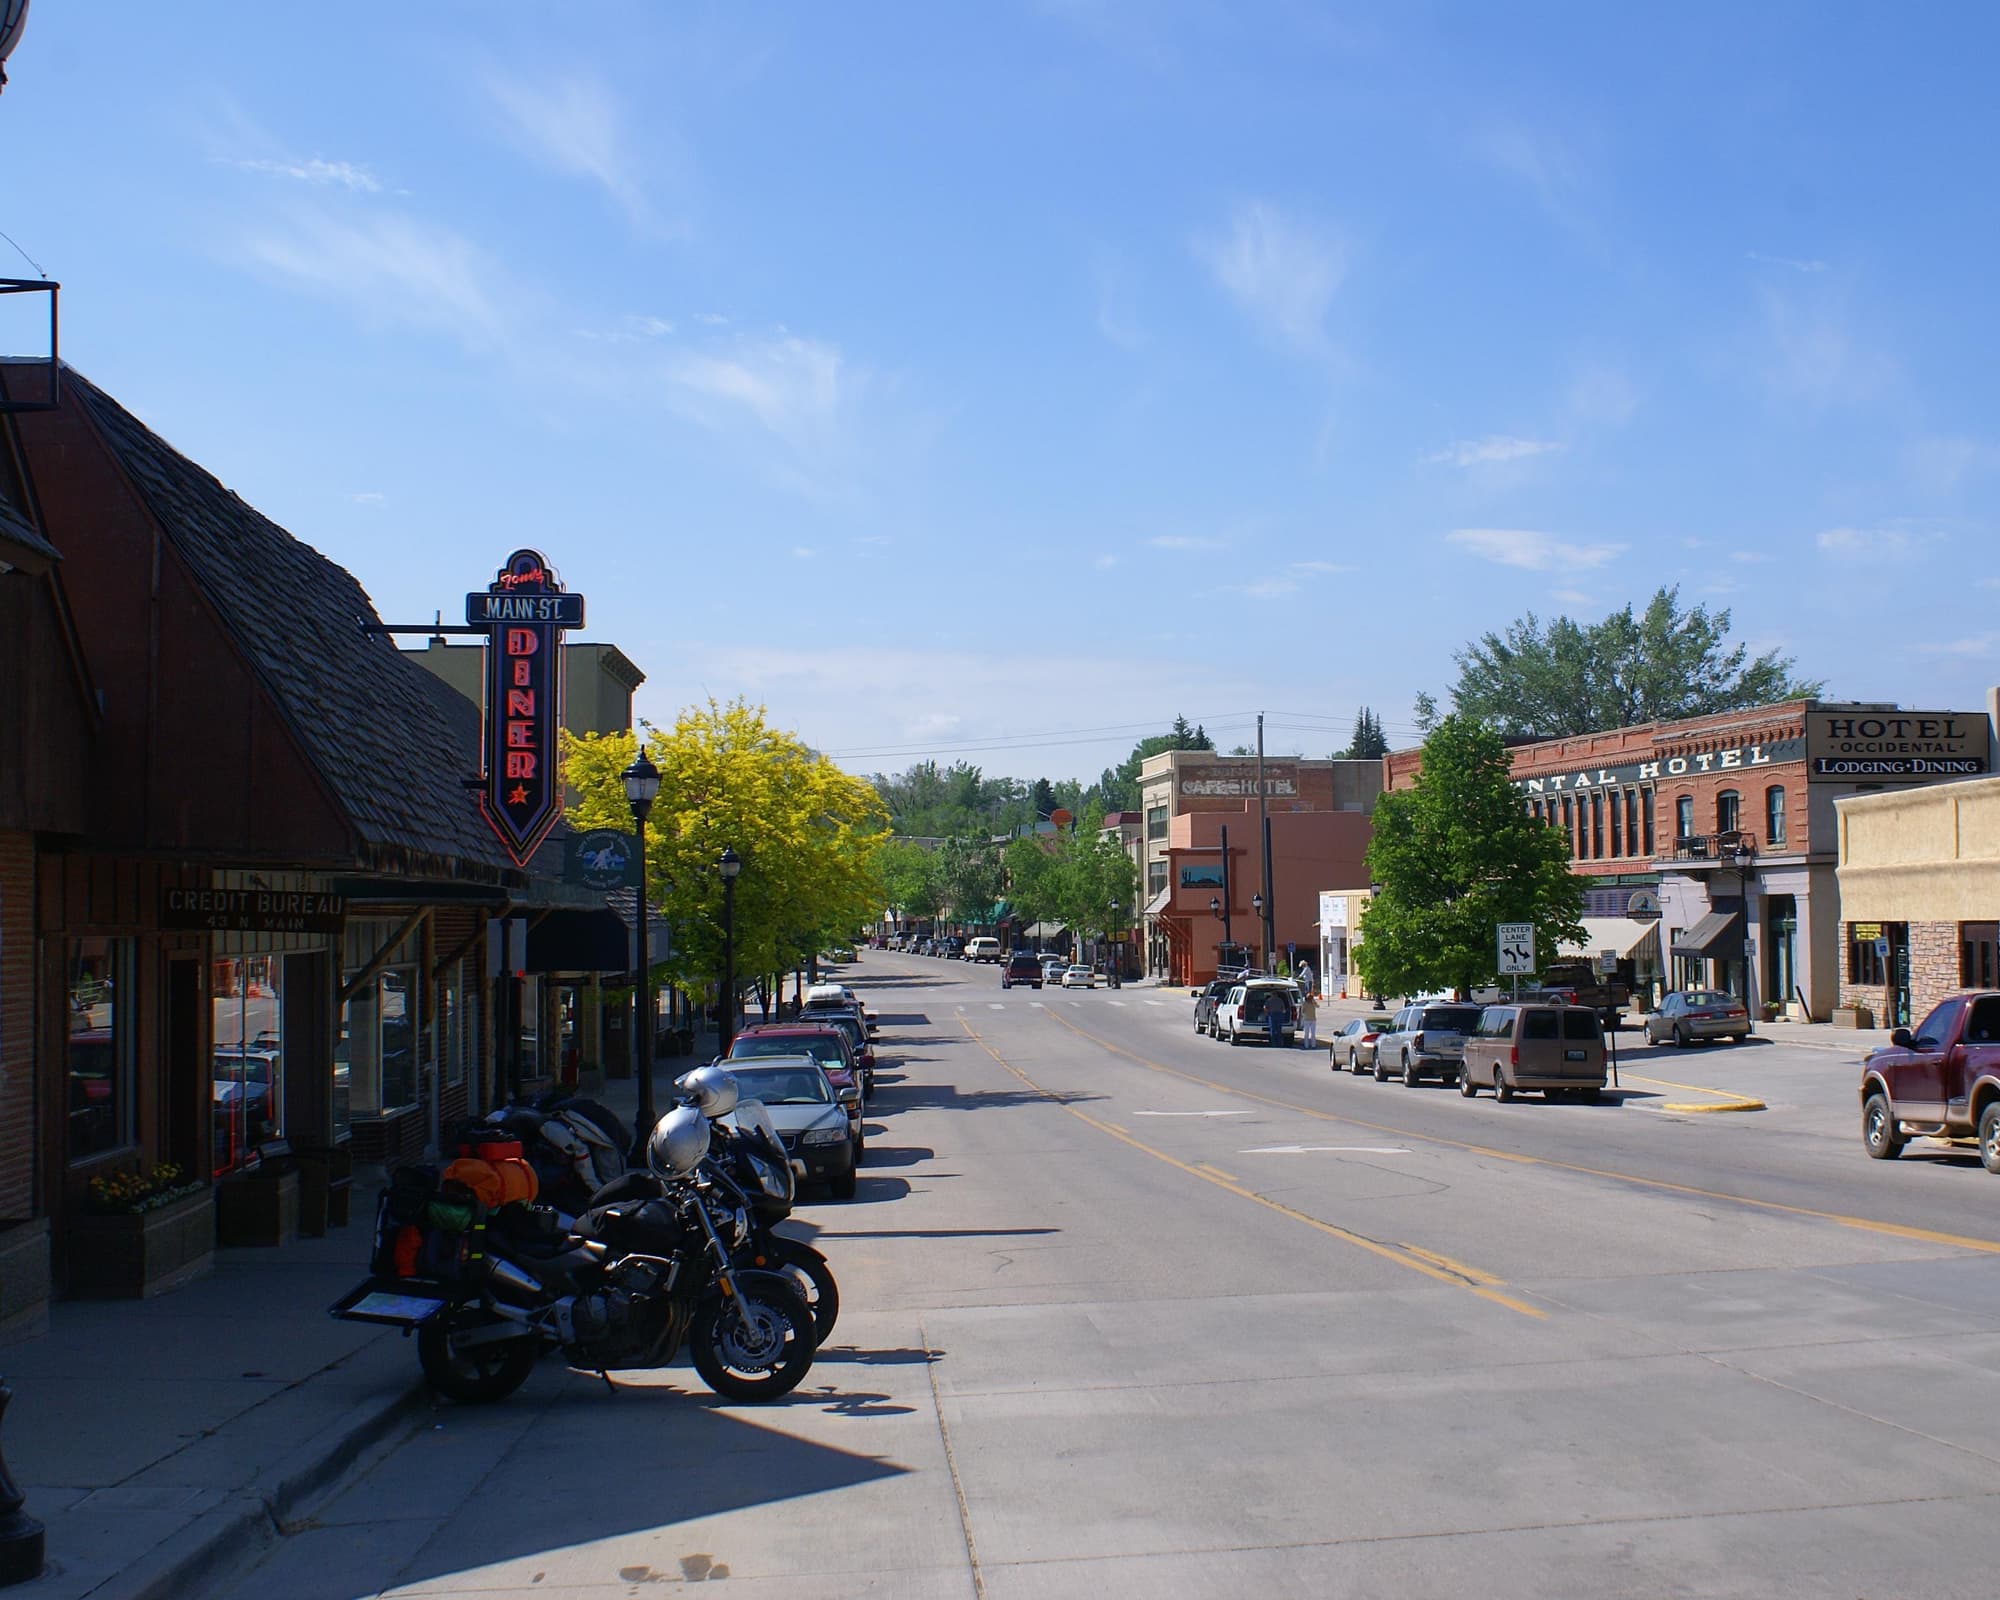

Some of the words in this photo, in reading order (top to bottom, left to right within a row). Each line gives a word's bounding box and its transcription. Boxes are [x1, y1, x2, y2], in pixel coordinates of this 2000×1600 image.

[507, 628, 540, 779] DINER
[1827, 719, 1966, 739] HOTEL
[1840, 742, 1957, 753] OCCIDENTAL
[1639, 746, 1769, 779] HOTEL
[169, 890, 248, 912] CREDIT
[258, 892, 342, 914] BUREAU
[207, 915, 228, 929] 43
[263, 916, 305, 930] MAIN
